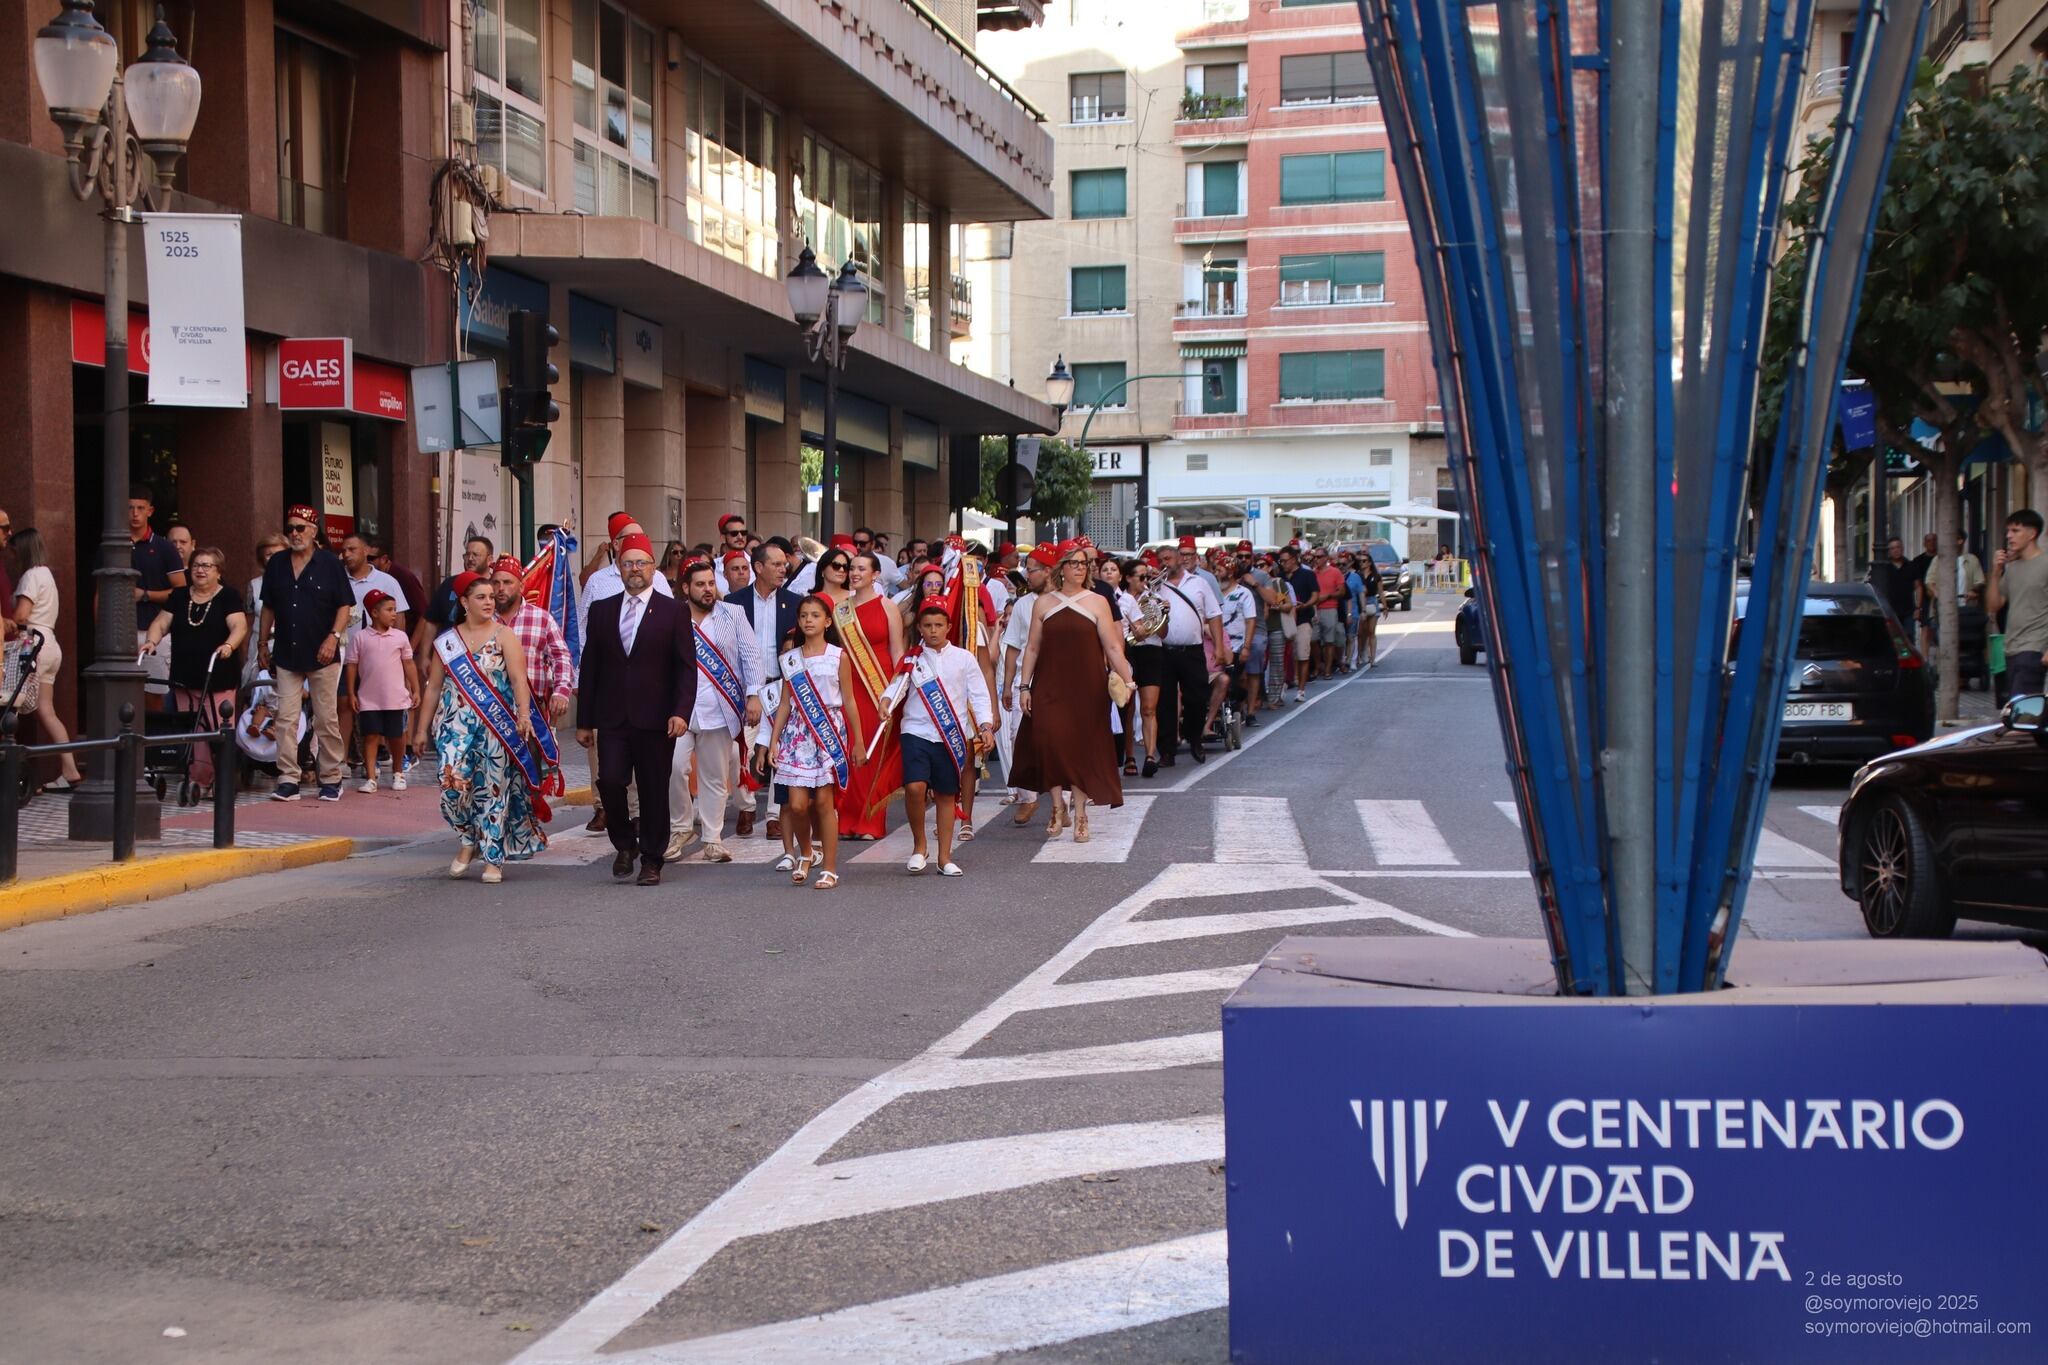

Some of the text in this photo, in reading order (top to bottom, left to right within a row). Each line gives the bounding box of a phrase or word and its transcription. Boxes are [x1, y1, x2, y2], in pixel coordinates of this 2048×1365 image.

[160, 231, 190, 243] 1525
[165, 246, 199, 258] 2025
[282, 358, 341, 379] GAES
[312, 379, 340, 387] amplifon
[380, 396, 402, 412] amplifon
[324, 444, 330, 455] EL
[324, 457, 344, 469] FUTURO
[325, 470, 341, 481] SUENA
[326, 482, 341, 494] COMO
[694, 636, 719, 671] Moros
[456, 662, 513, 736] Moros Viejos
[798, 682, 836, 752] Moros Viejos
[1784, 704, 1844, 716] 8067 FBC
[929, 690, 964, 758] Moros Viejos
[1488, 1099, 1965, 1151] V CENTENARIO
[1456, 1164, 1695, 1214] CIVDAD
[1438, 1230, 1792, 1282] DE VILLENA
